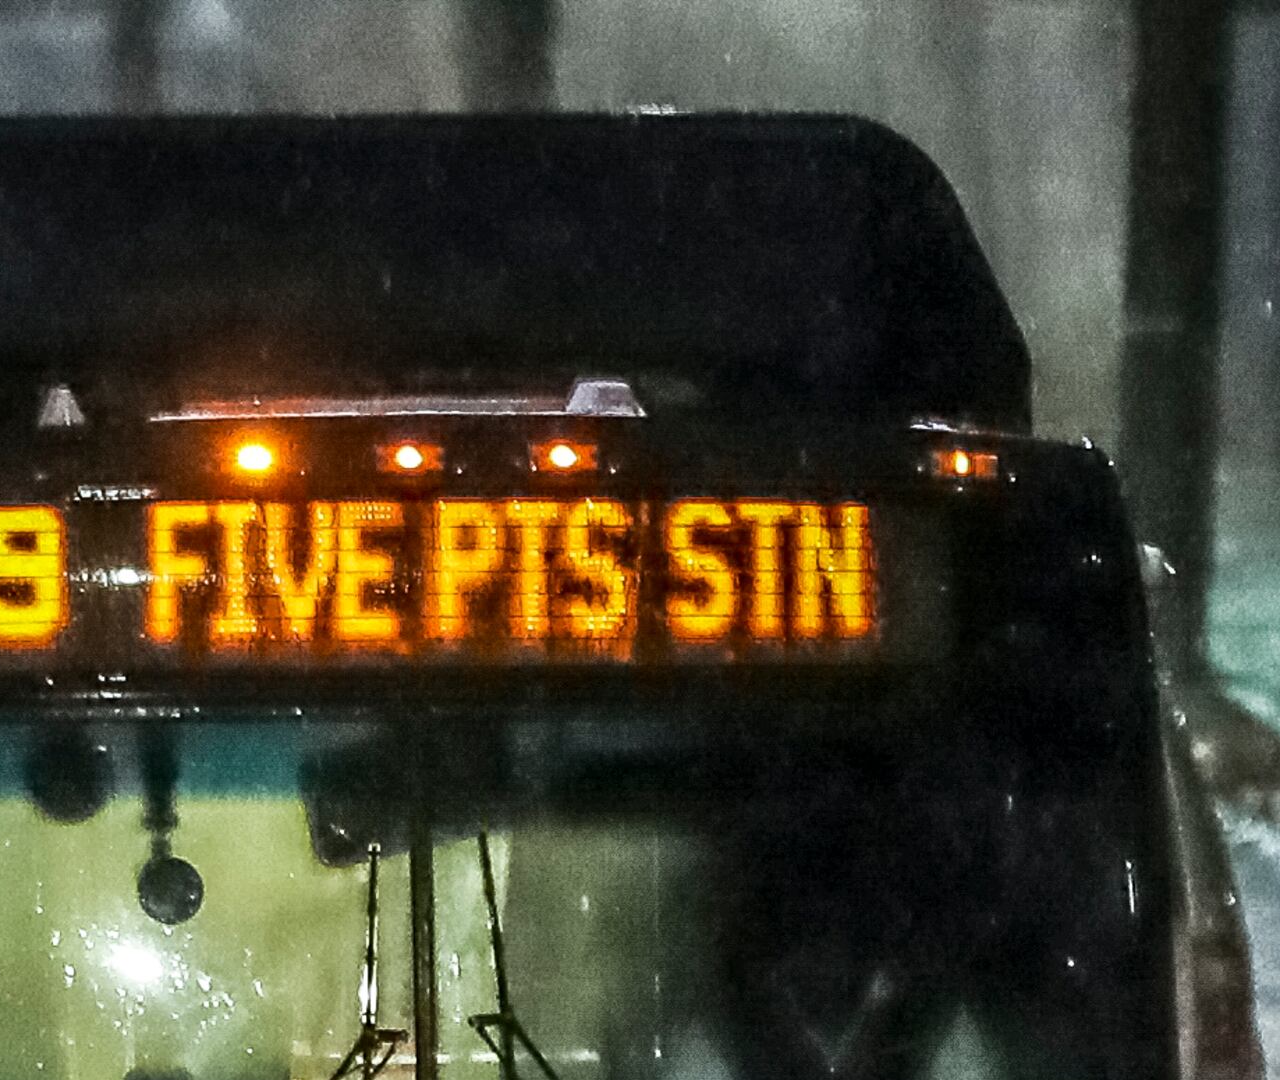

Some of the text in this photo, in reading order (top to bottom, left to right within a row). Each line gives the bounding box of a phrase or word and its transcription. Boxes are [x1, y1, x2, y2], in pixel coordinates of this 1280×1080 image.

[146, 500, 404, 644] FIVE
[428, 499, 630, 644] PTS
[664, 500, 872, 638] STN
